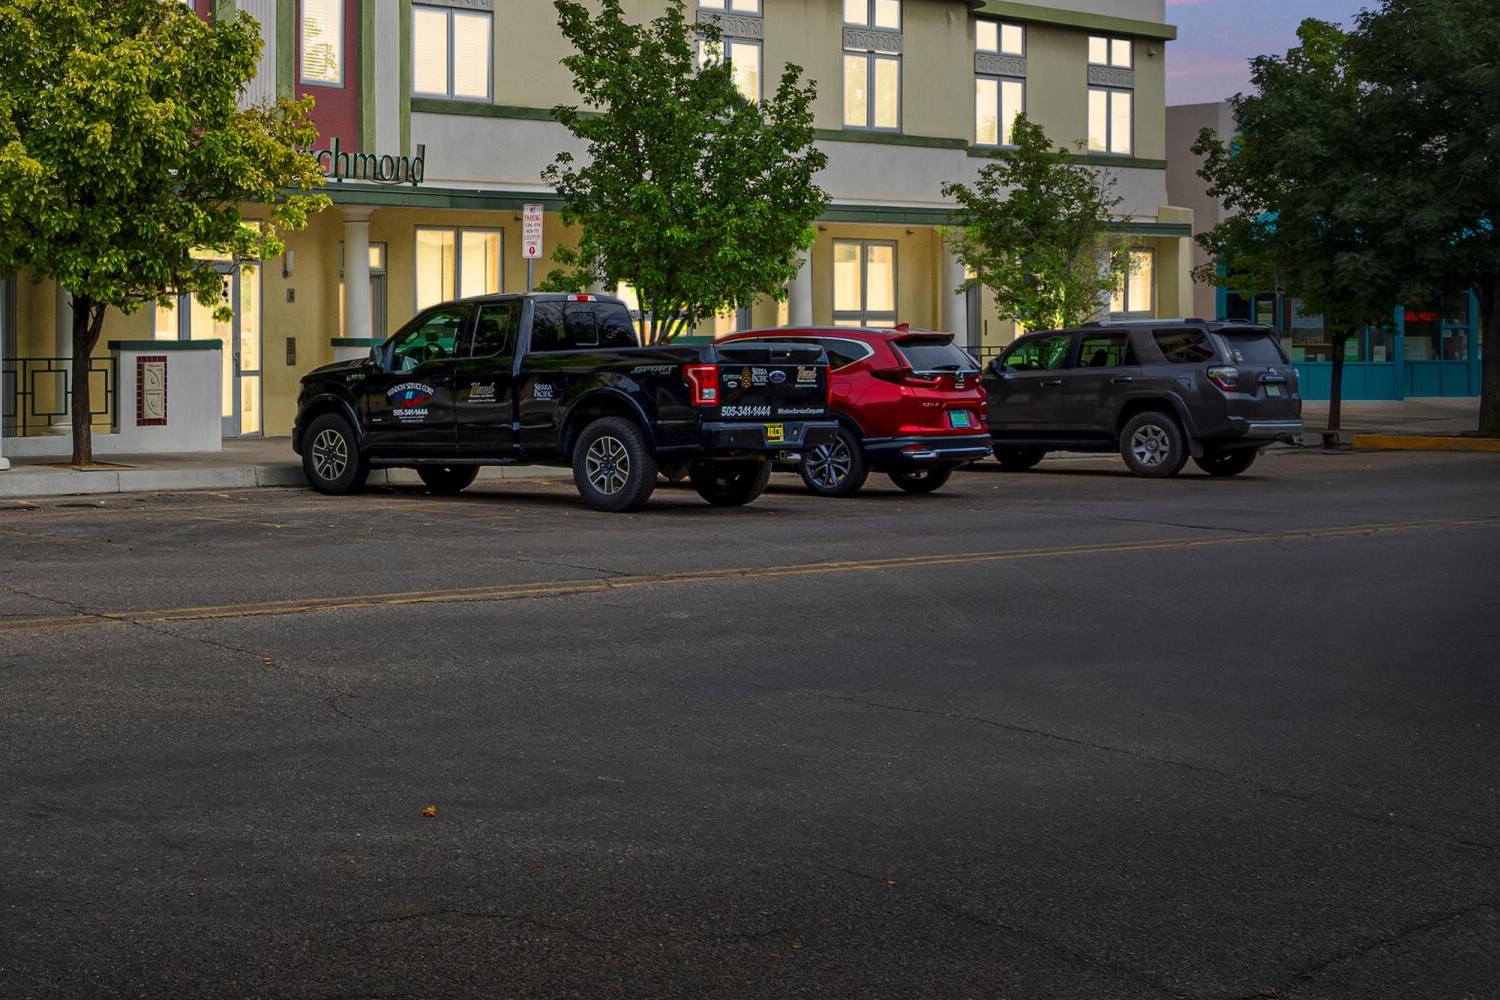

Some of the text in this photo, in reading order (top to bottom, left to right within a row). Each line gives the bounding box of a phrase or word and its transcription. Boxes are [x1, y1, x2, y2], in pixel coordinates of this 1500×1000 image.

[630, 364, 678, 375] SPORT
[752, 367, 768, 375] SIERRA
[752, 374, 768, 383] PACIFIC
[406, 382, 422, 391] SERVICE
[534, 383, 553, 391] SIERRA
[534, 389, 553, 398] PACIFIC
[392, 408, 429, 417] 505-341-1444
[721, 405, 771, 417] 505-341-1444
